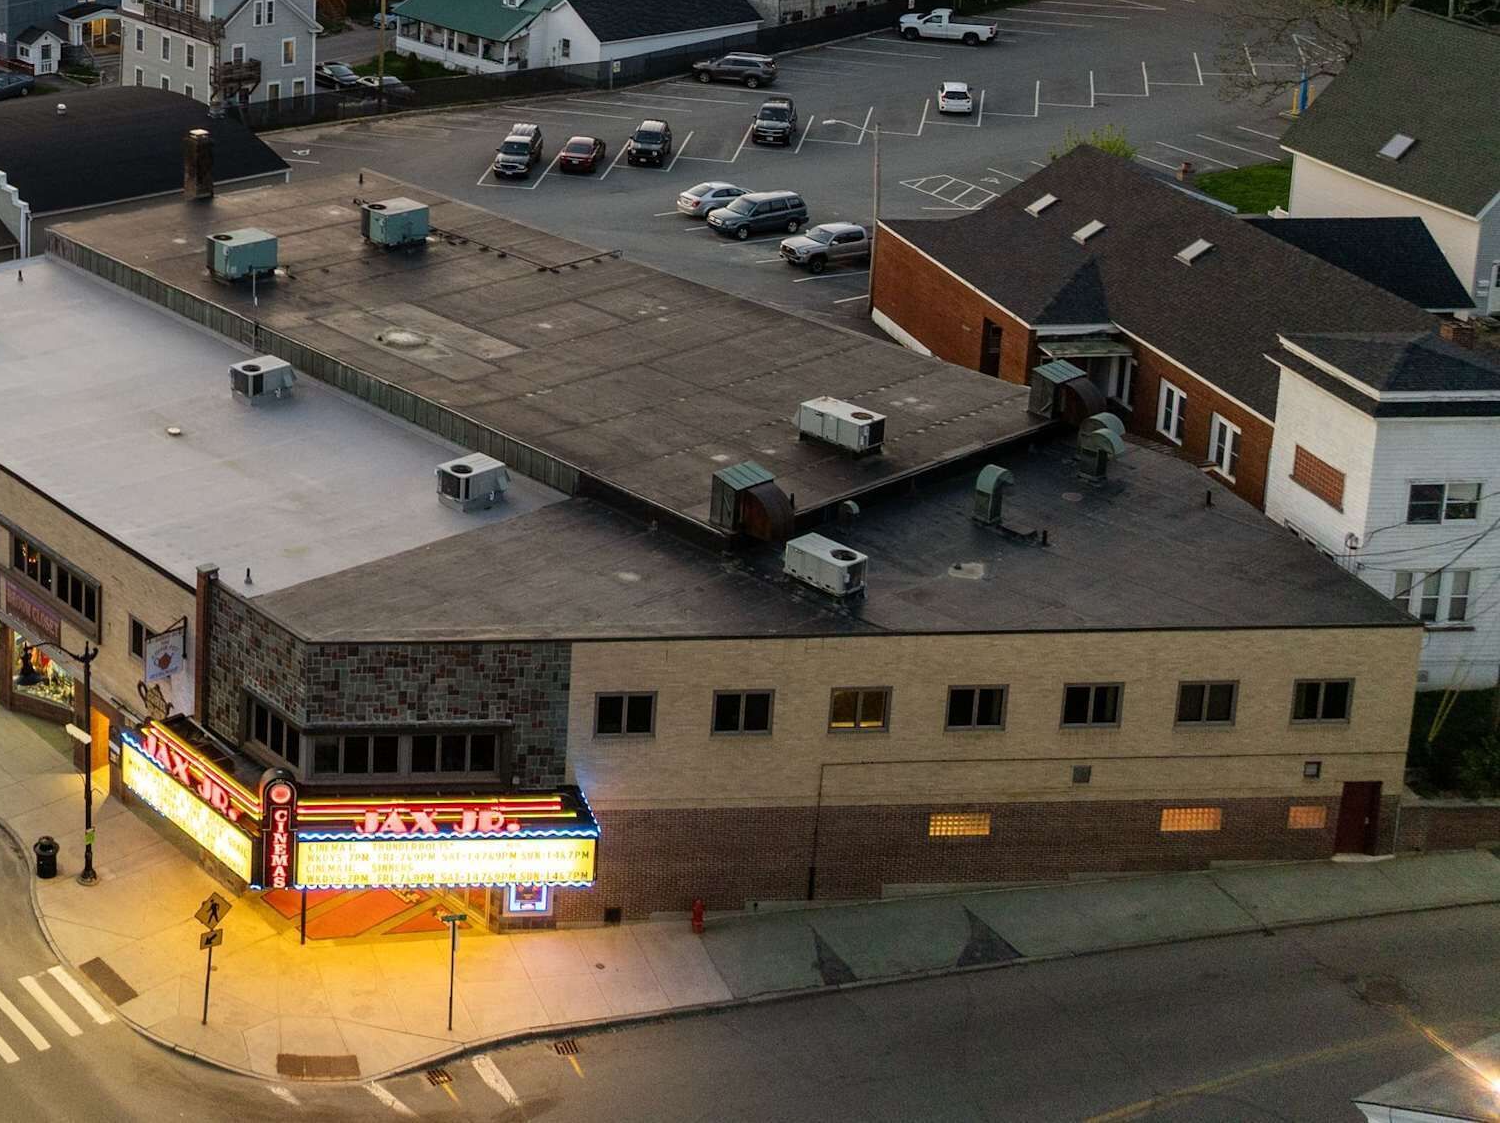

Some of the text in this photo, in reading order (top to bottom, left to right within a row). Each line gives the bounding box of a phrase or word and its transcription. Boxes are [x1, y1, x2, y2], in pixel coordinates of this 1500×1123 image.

[143, 734, 241, 822] JAX JR.
[271, 810, 288, 888] CINEMAS
[355, 811, 520, 833] JAX JR.
